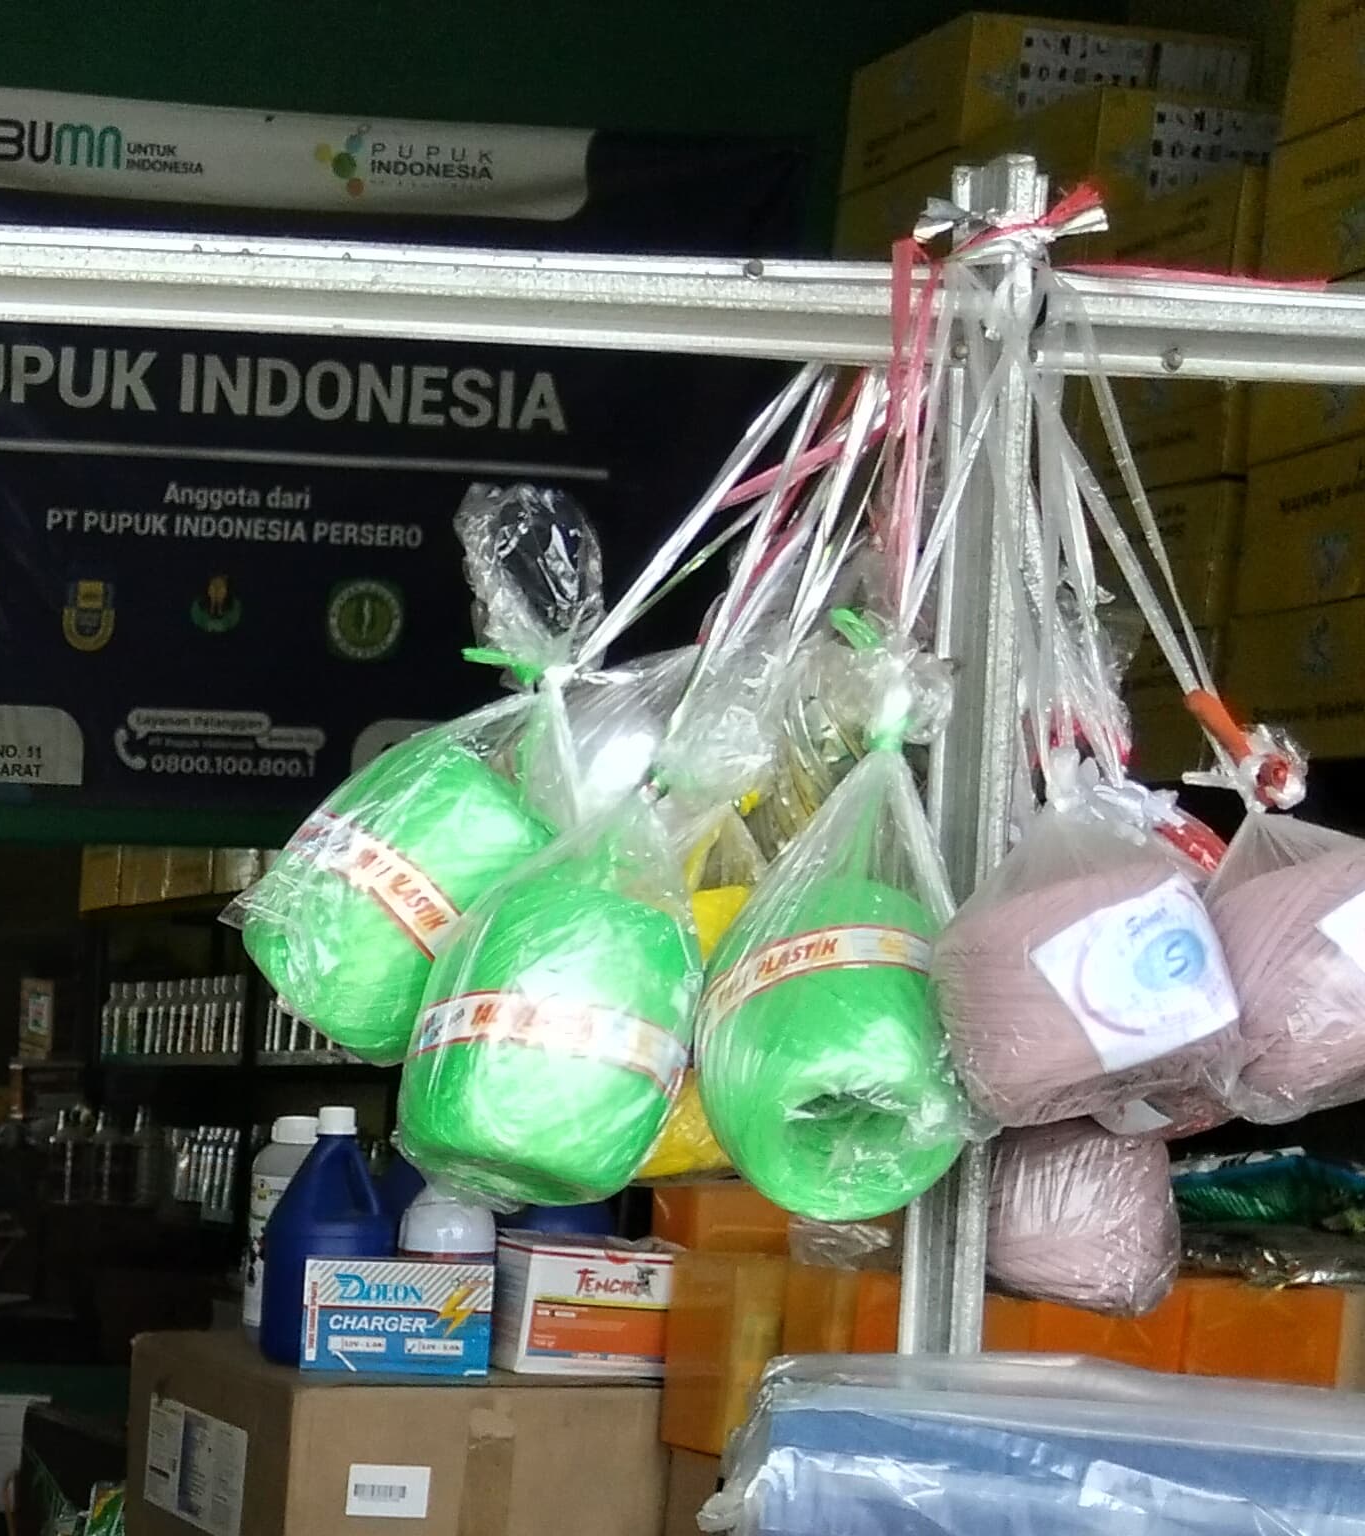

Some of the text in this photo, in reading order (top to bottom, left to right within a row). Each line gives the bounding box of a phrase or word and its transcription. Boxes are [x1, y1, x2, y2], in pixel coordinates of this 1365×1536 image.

[126, 141, 178, 159] UNTUK
[371, 139, 495, 166] PUPUK
[125, 156, 205, 176] INDONESIA
[371, 159, 495, 182] INDONESIA
[180, 353, 569, 435] INDONESIA
[163, 481, 312, 512] Anggota dari
[45, 509, 424, 549] PT PUPUK INDONESIA PERSERO
[328, 1314, 427, 1334] CHARGER
